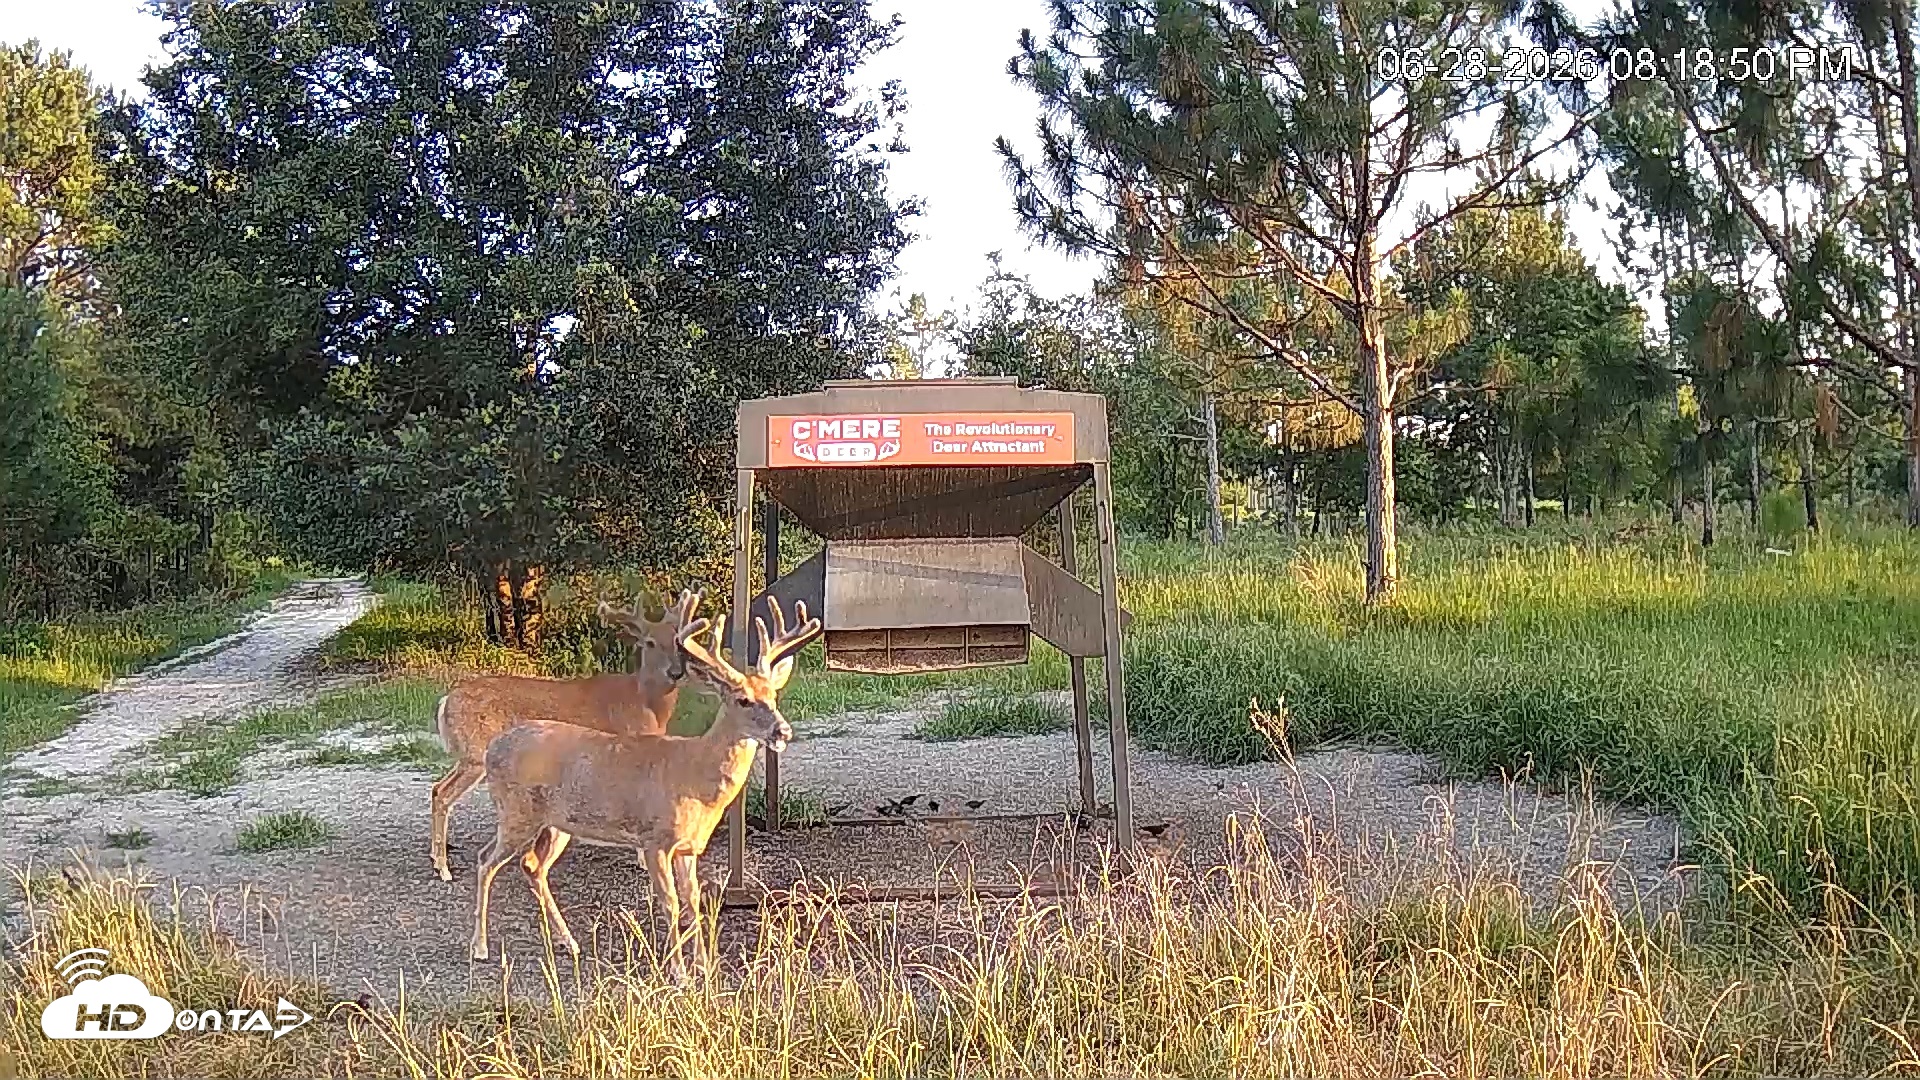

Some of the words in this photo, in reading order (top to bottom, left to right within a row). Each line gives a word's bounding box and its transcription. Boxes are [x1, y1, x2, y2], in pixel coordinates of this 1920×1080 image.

[793, 419, 901, 439] C'MERE
[924, 423, 952, 436] The
[955, 422, 1056, 437] Revolutionary
[822, 447, 871, 457] DEER
[932, 440, 968, 453] Deer
[971, 440, 1045, 453] Attractant
